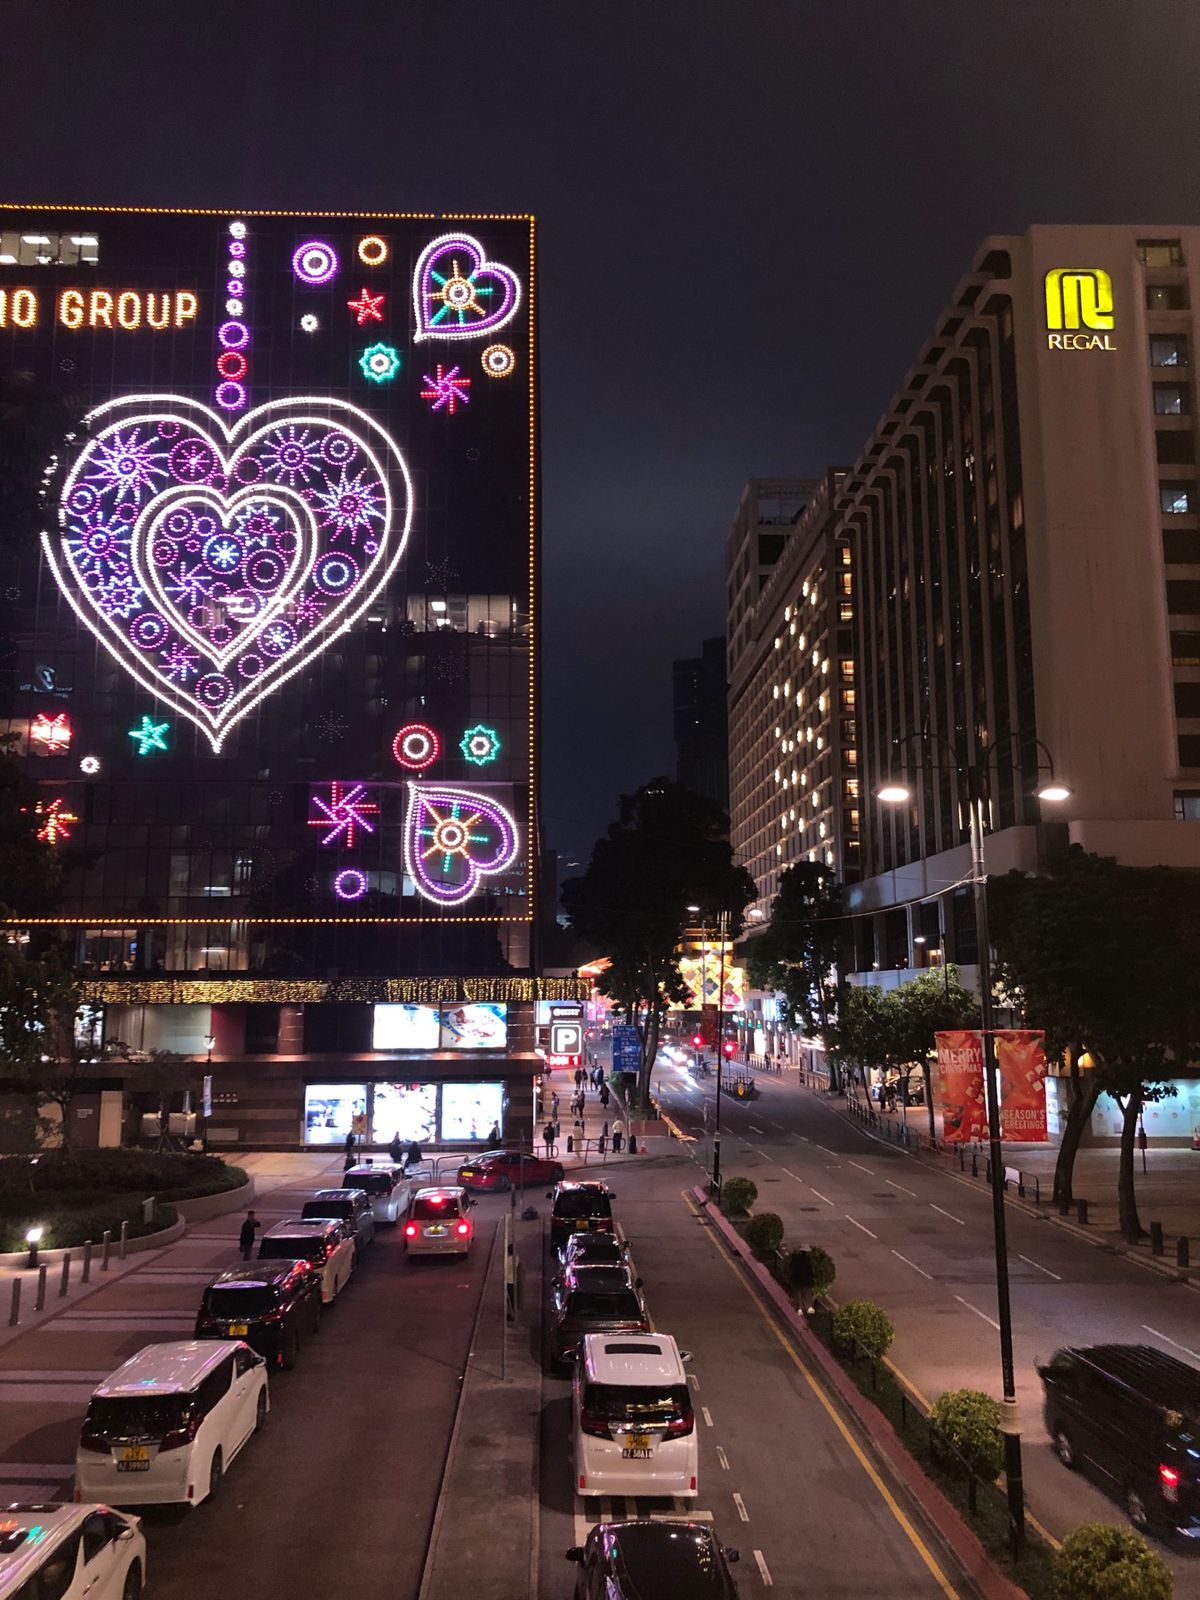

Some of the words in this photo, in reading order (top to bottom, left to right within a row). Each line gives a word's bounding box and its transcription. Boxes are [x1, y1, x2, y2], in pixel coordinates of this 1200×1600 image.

[0, 289, 38, 328] O
[59, 290, 197, 329] GROUP
[1048, 334, 1117, 350] REGAL
[557, 1029, 577, 1052] P
[940, 1048, 981, 1063] MERRY
[940, 1064, 981, 1073] CHRISTMAS
[1003, 1109, 1045, 1120] SEASON'S
[1004, 1120, 1045, 1130] GREETINGS
